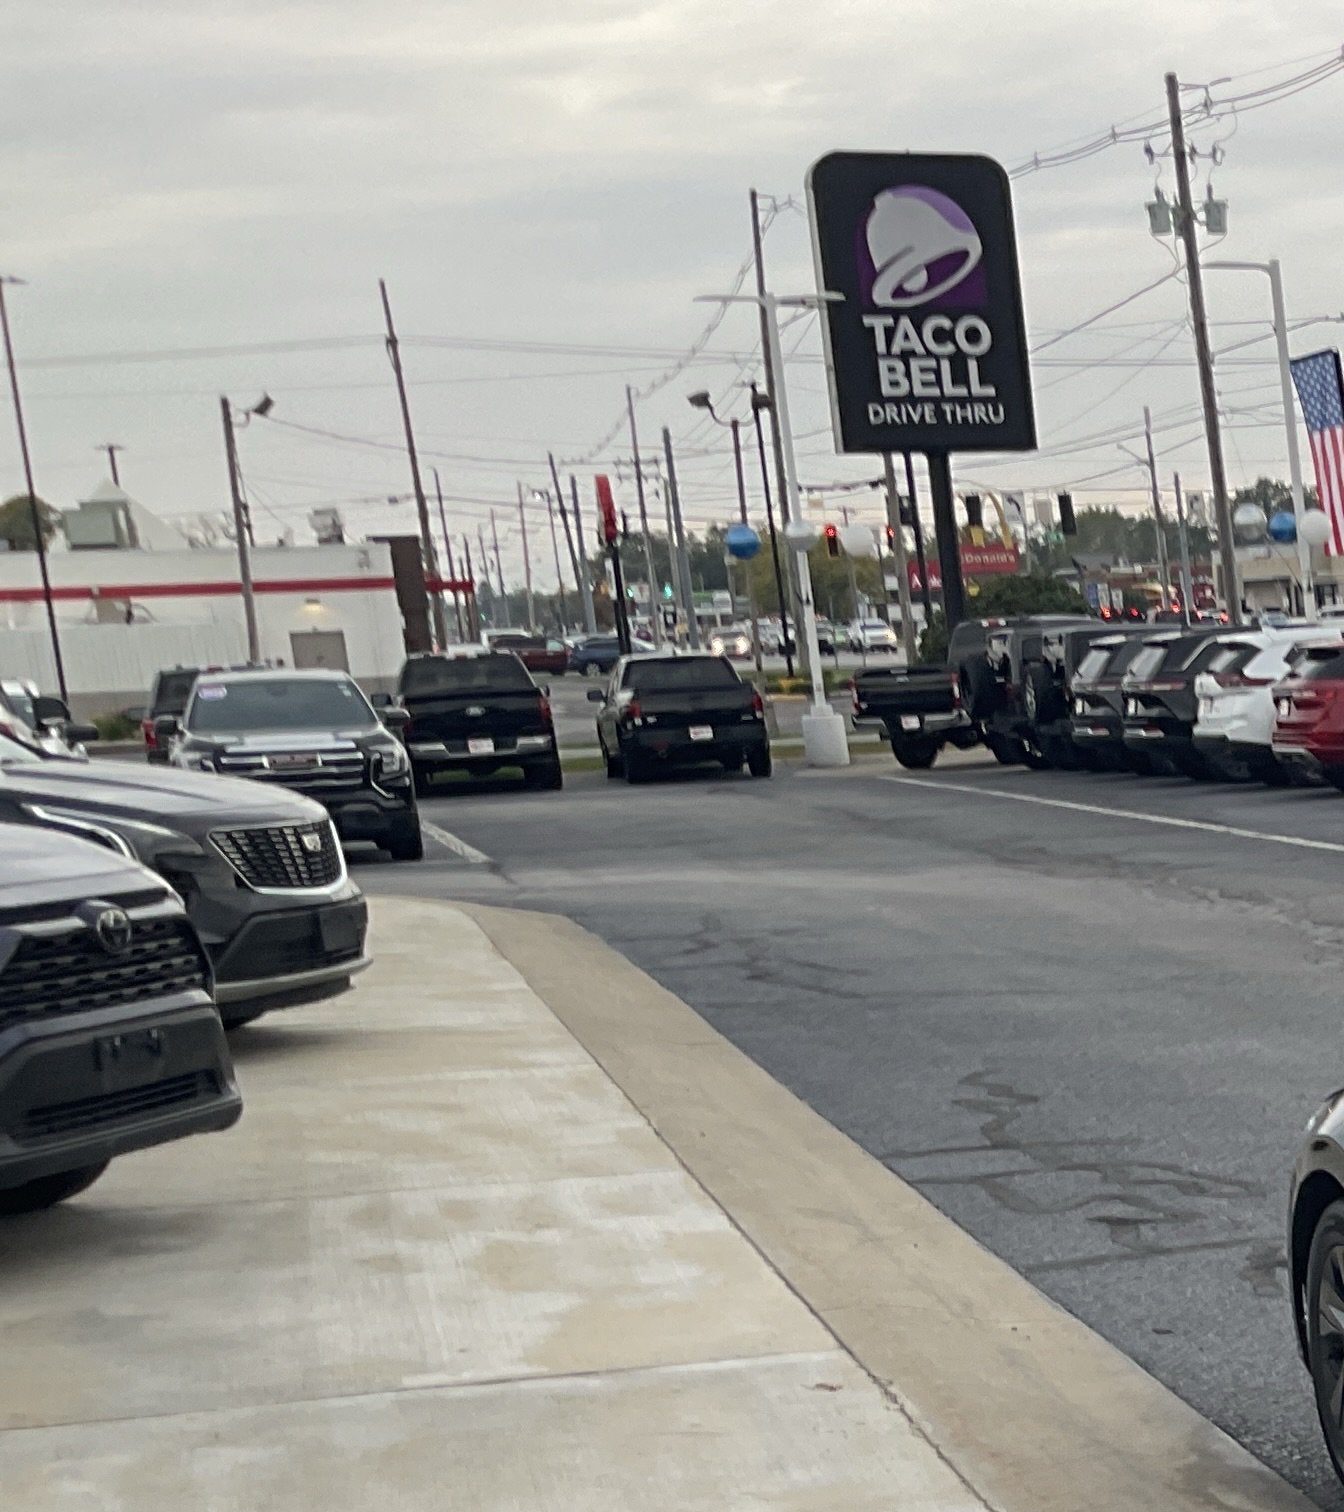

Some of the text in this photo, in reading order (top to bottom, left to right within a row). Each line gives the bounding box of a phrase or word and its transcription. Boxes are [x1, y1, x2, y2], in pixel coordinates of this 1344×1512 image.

[862, 314, 992, 356] TACO
[878, 356, 996, 398] BELL
[867, 402, 1005, 425] DRIVE THRU
